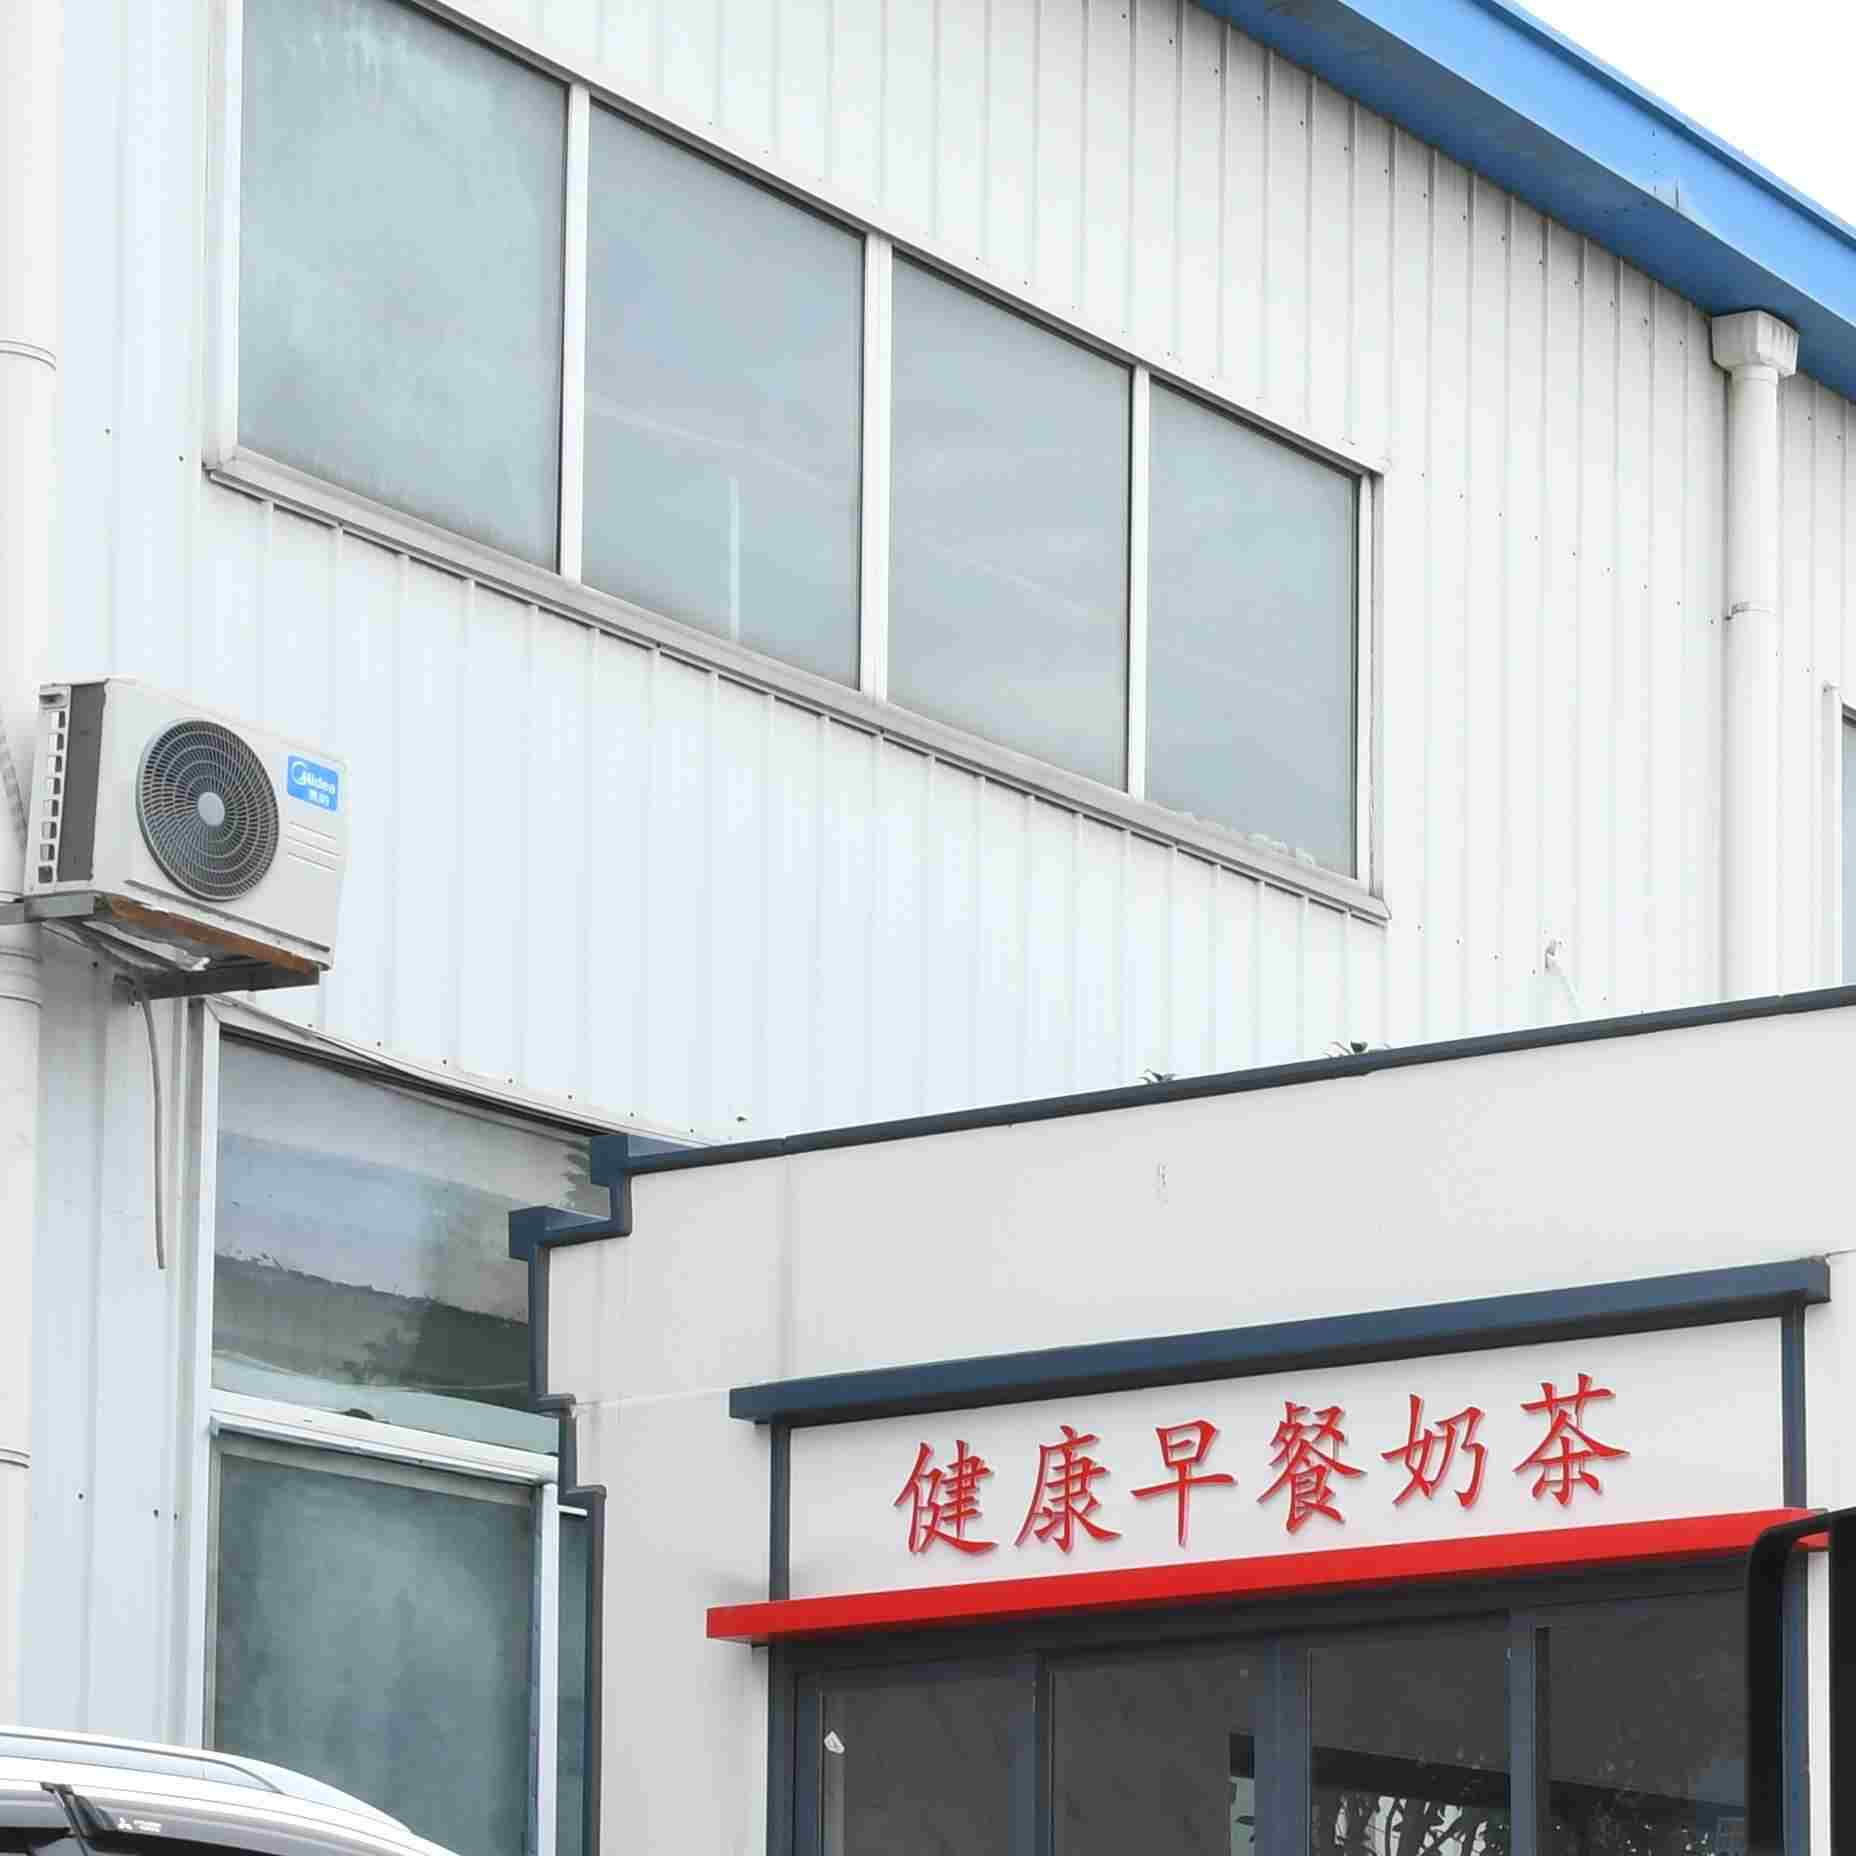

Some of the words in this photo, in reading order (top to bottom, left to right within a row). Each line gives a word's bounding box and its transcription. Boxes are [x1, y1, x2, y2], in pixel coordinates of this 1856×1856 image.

[895, 1372, 1632, 1554] 健康早餐奶茶
